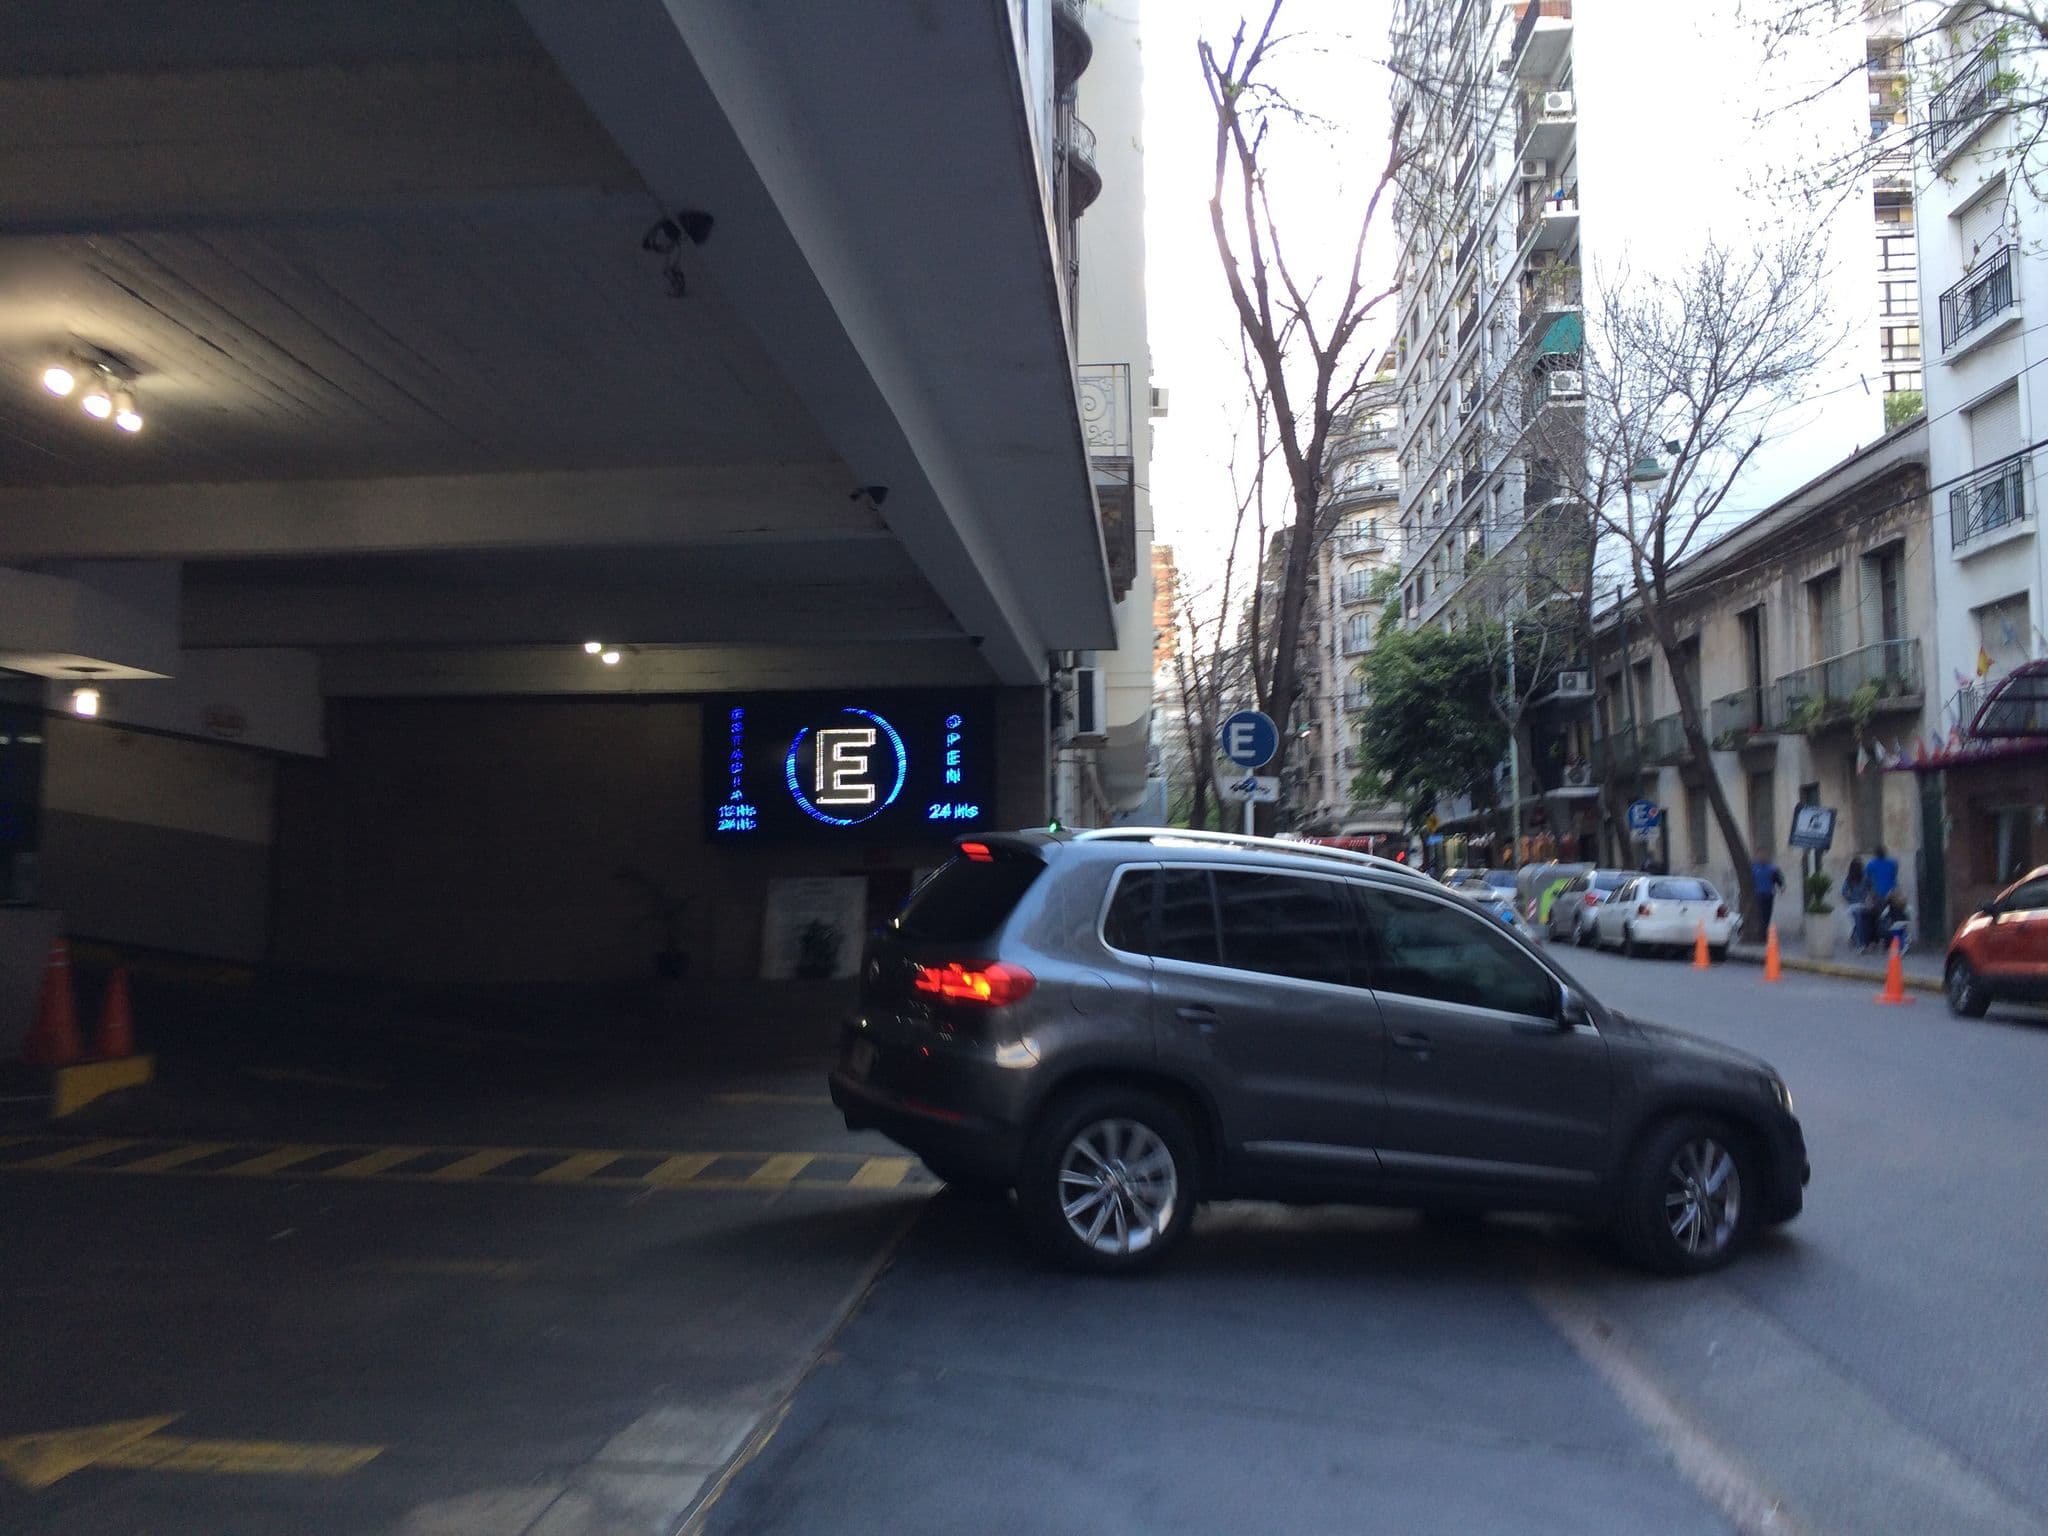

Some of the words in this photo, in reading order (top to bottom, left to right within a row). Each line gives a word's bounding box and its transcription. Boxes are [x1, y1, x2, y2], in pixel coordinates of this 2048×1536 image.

[946, 714, 962, 784] OPEN
[1230, 722, 1256, 757] E
[815, 727, 877, 805] E
[929, 803, 951, 819] 24
